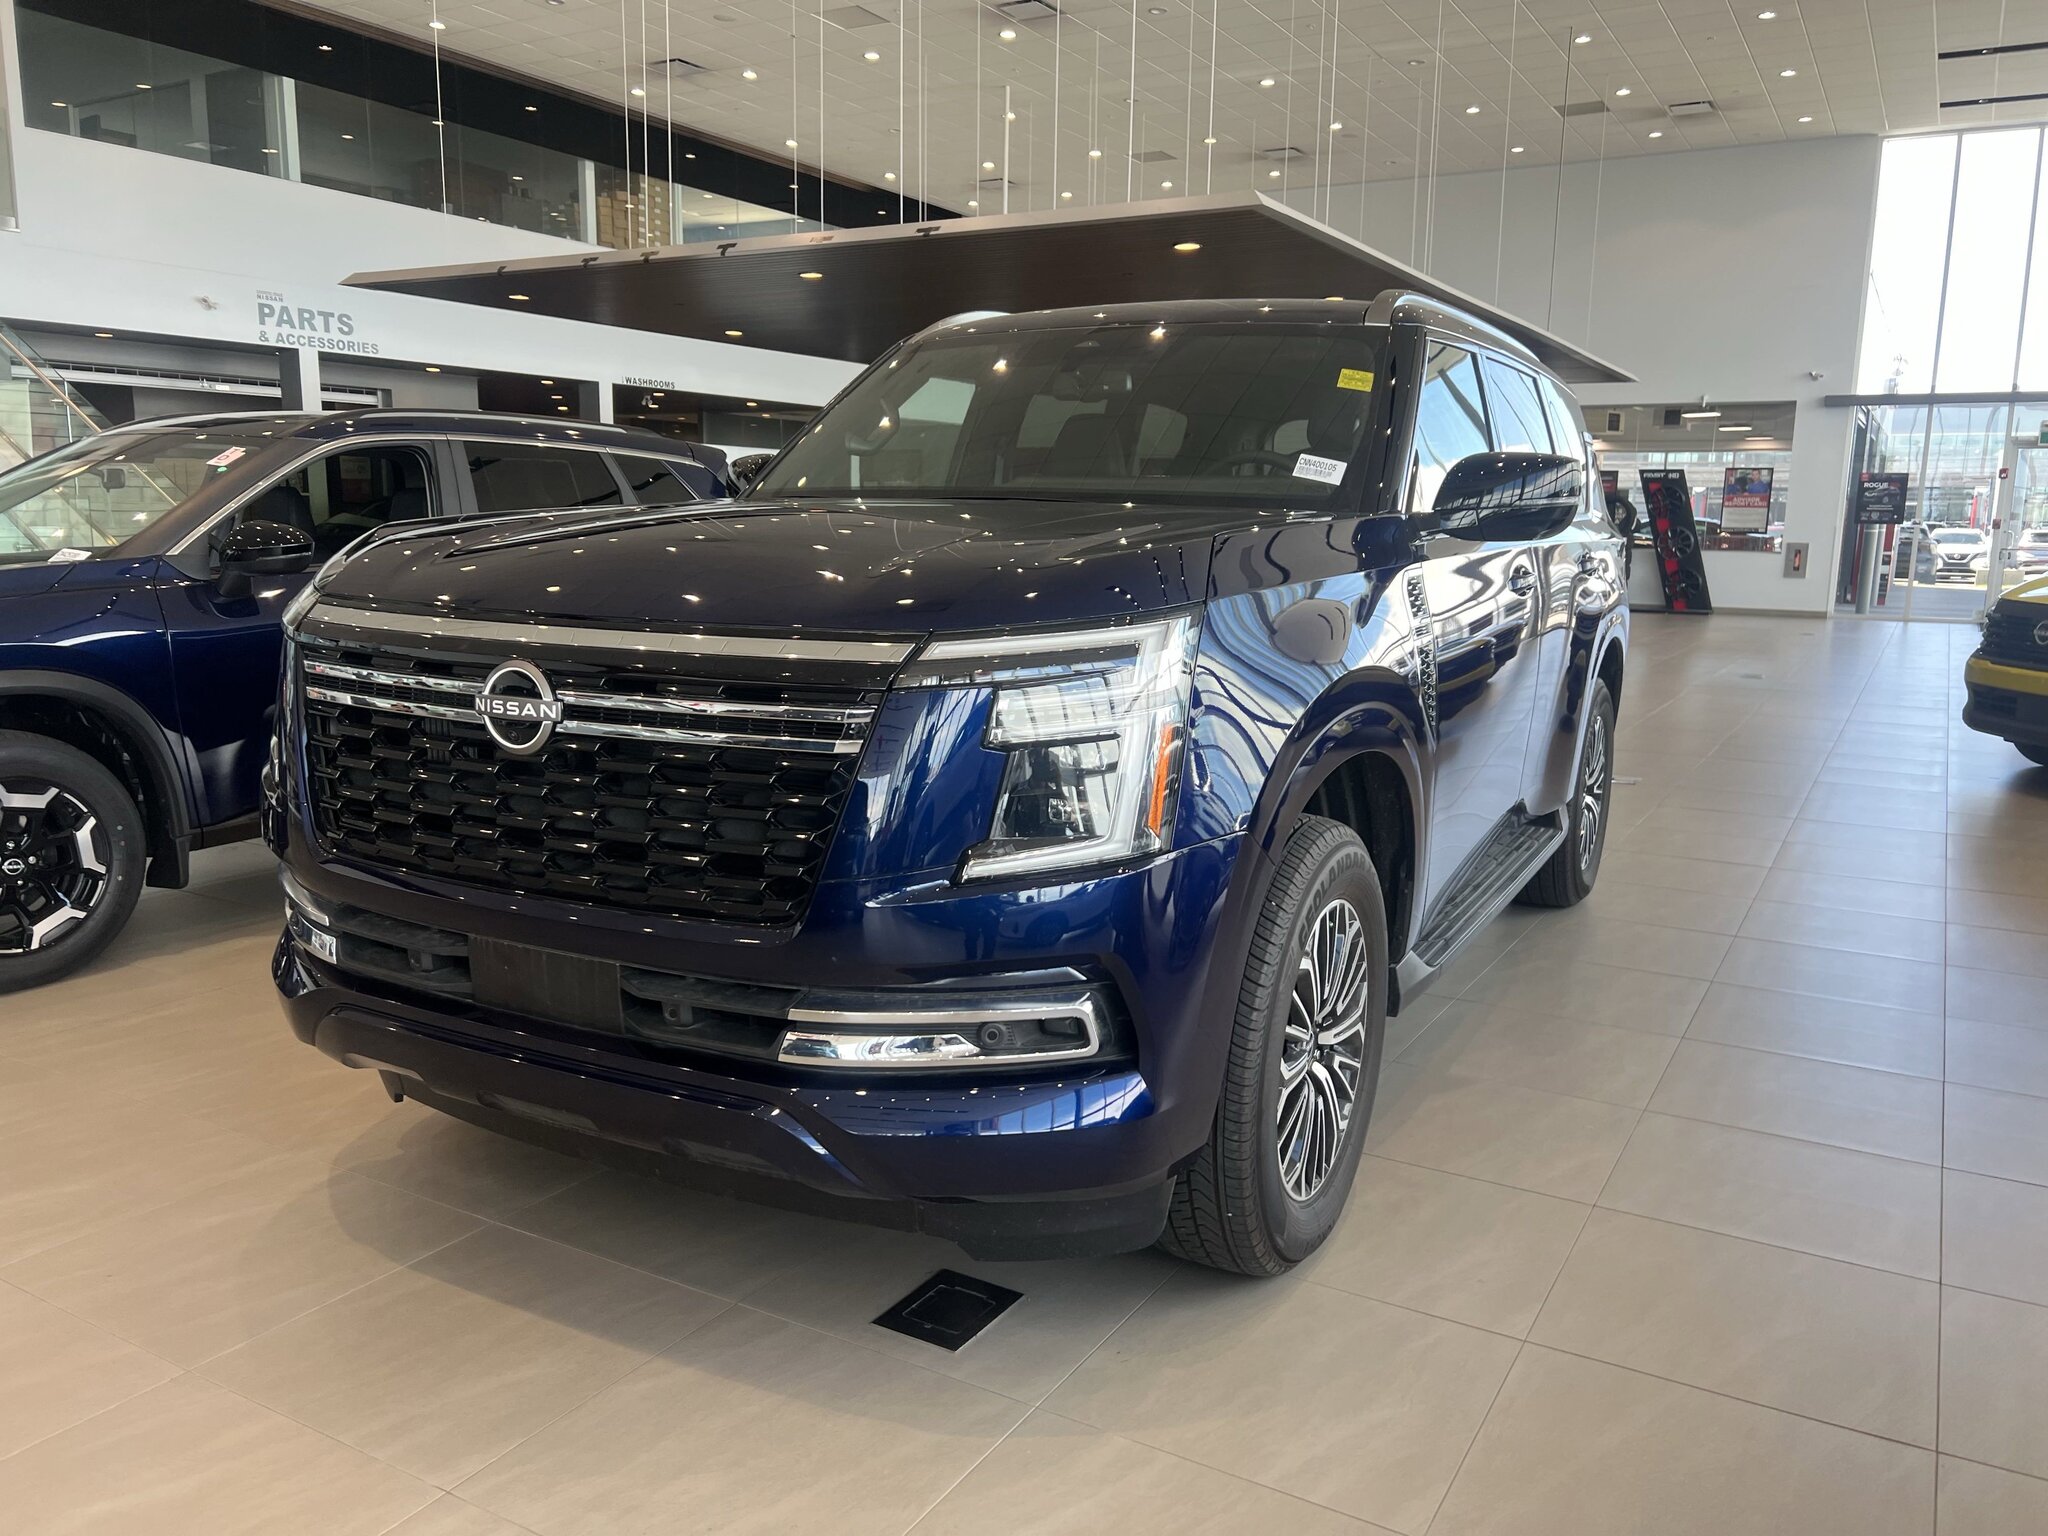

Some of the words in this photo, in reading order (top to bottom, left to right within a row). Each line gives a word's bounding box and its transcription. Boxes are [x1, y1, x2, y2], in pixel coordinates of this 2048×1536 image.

[256, 294, 284, 303] NISSAN
[257, 302, 355, 336] PARTS
[258, 330, 270, 343] &
[275, 332, 380, 355] ACCESSORIES
[625, 376, 676, 390] WASHROOMS
[475, 697, 557, 719] NISSAN
[1298, 851, 1368, 951] GEOLANDAR
